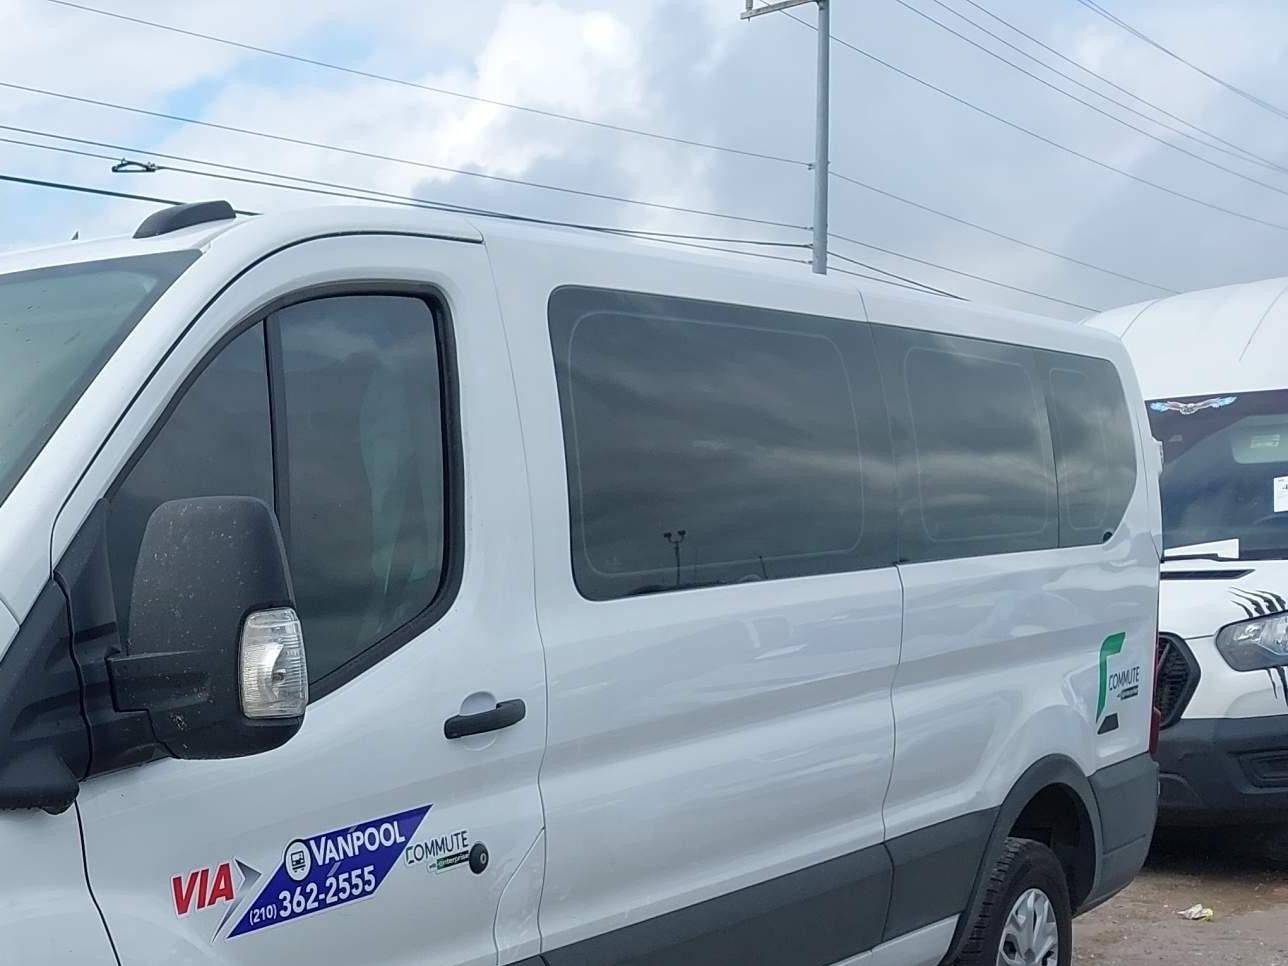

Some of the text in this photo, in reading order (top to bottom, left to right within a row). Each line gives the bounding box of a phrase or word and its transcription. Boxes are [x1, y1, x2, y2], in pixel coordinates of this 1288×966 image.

[1109, 666, 1140, 691] COMMUTE
[310, 820, 406, 866] VANPOOL
[405, 830, 469, 864] COMMUTE
[171, 863, 235, 915] VIA
[249, 865, 376, 926] (210) 362-2555
